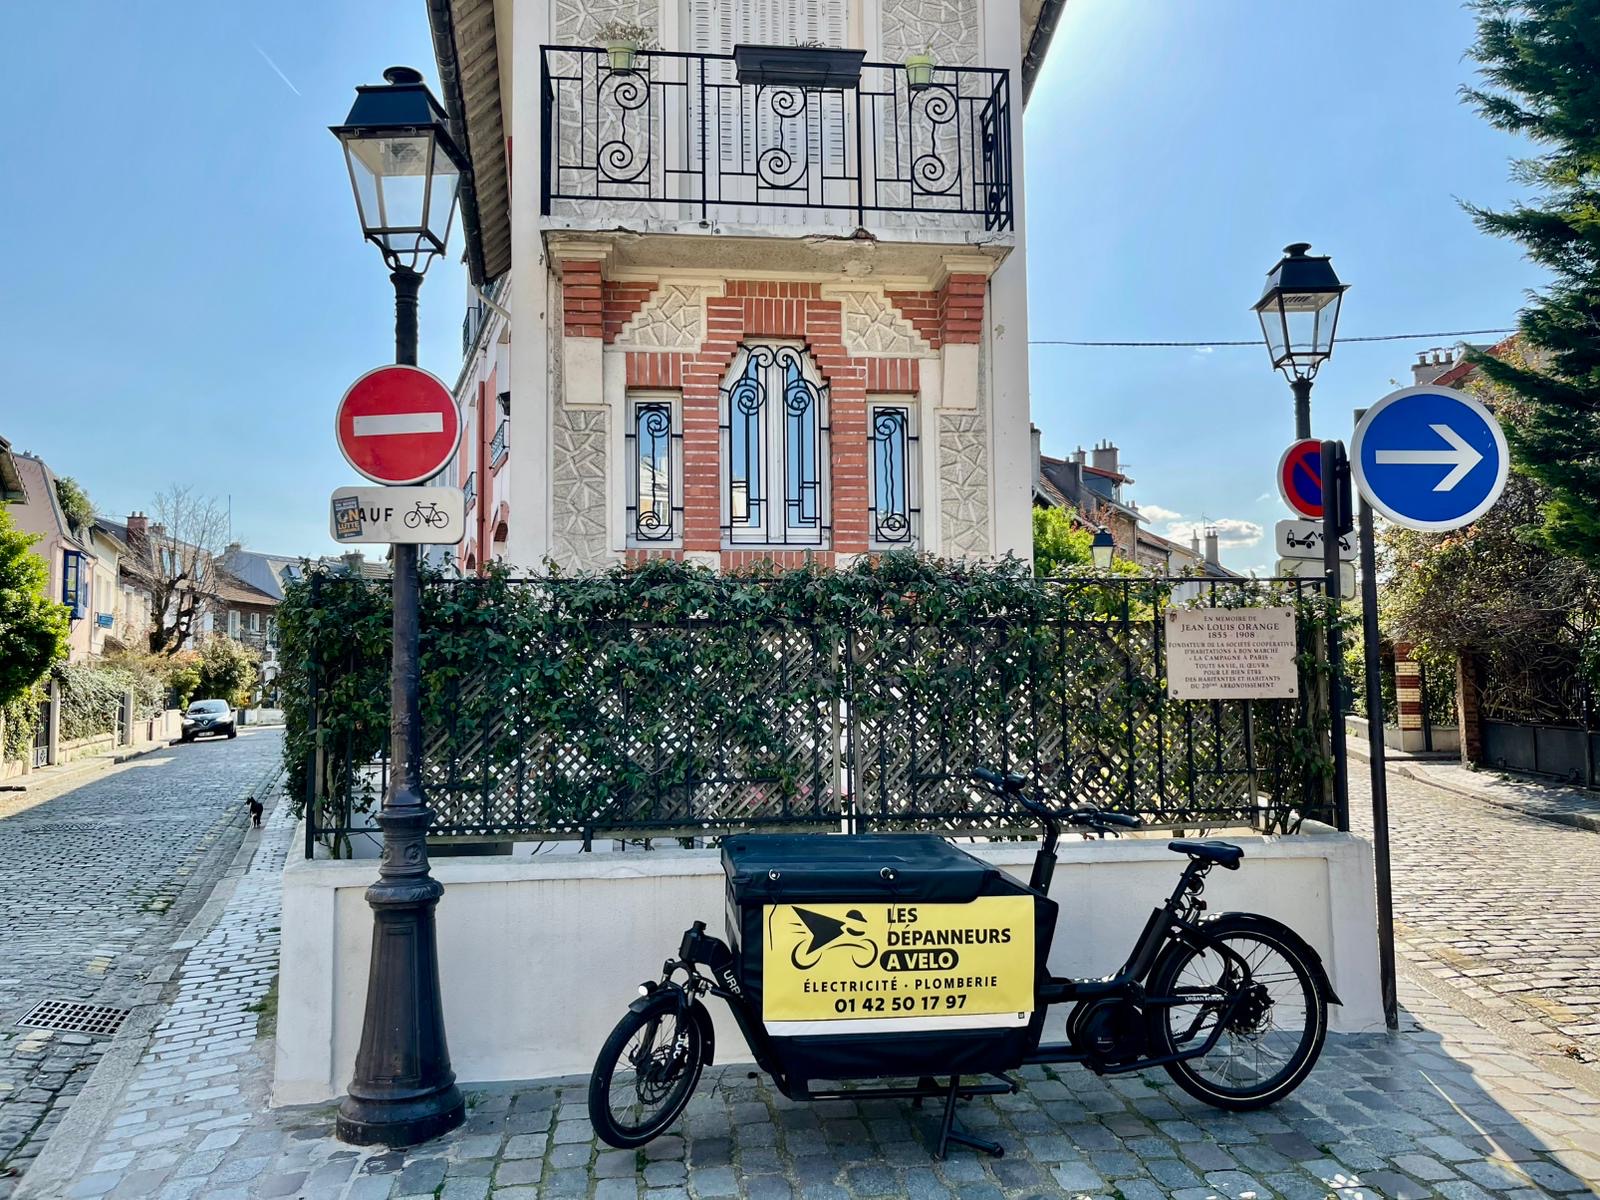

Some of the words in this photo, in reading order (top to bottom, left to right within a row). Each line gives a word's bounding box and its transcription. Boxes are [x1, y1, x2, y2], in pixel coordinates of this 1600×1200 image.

[359, 507, 394, 522] AUF
[1181, 624, 1204, 632] JEAN
[1237, 623, 1280, 631] ORANGE
[887, 908, 918, 924] LES
[887, 925, 1011, 947] DÉPANNEURS
[886, 953, 901, 970] A
[904, 951, 954, 970] VELO
[803, 976, 898, 993] ÉLECTRICITÉ
[914, 976, 998, 991] PLOMBERIE
[834, 998, 856, 1013] 01
[862, 997, 885, 1012] 42
[891, 996, 915, 1012] 50
[922, 995, 941, 1010] 17
[945, 994, 967, 1010] 97
